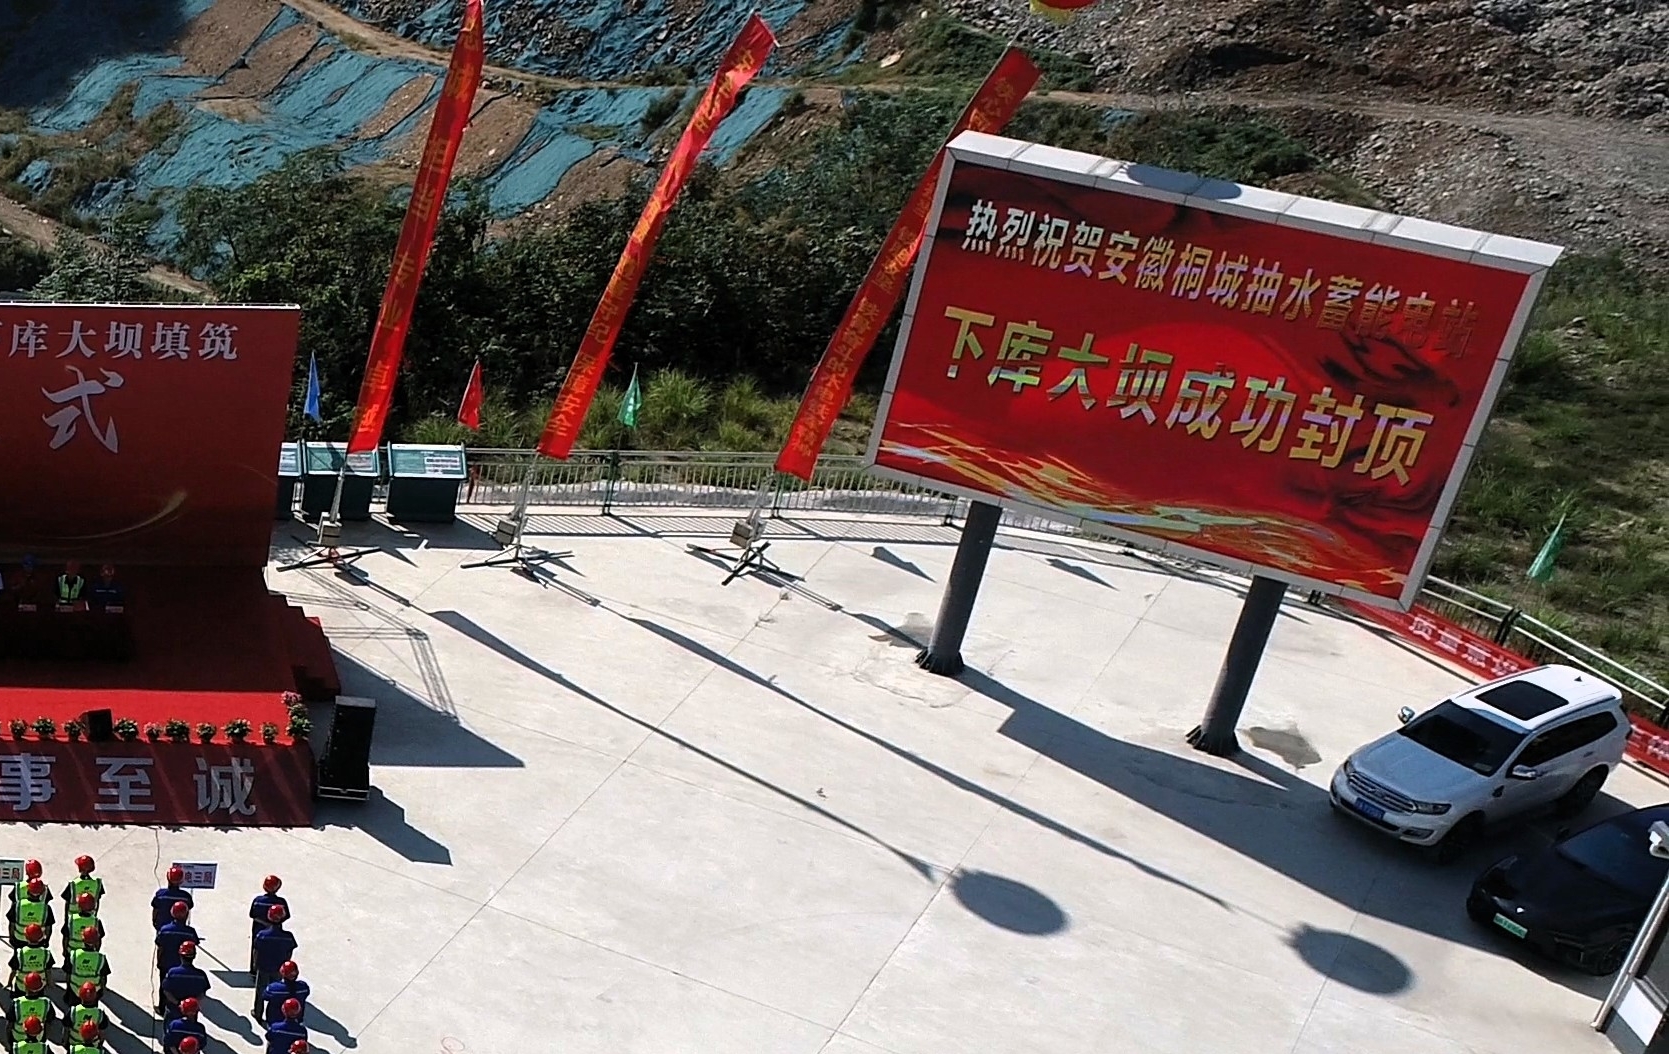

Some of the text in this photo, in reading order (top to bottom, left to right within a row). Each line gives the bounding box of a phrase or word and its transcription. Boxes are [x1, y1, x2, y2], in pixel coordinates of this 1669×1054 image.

[961, 198, 1480, 359] 热烈祝贺安徽桐城抽水蓄能电站
[545, 351, 600, 437] 保障安全
[943, 304, 1435, 487] 下库大坝成功封顶
[182, 871, 213, 883] 电三局
